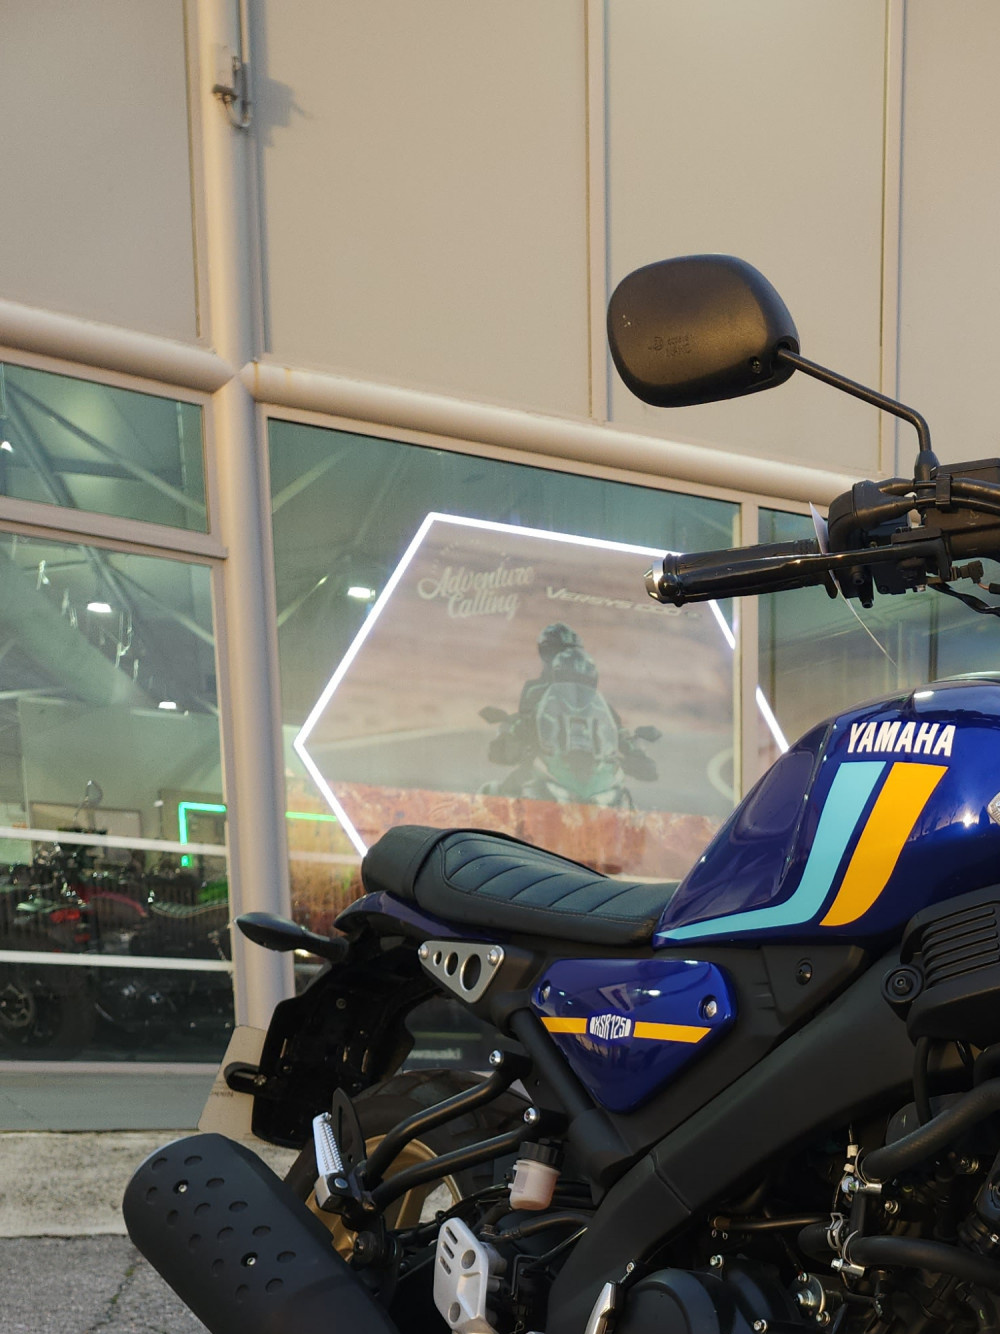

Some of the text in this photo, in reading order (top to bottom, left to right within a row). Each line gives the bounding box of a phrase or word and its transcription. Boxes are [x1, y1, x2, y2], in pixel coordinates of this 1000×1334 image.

[417, 557, 534, 600] Adventure
[448, 588, 519, 621] Calling
[847, 721, 957, 757] YAMAHA
[592, 1013, 628, 1040] XSR125
